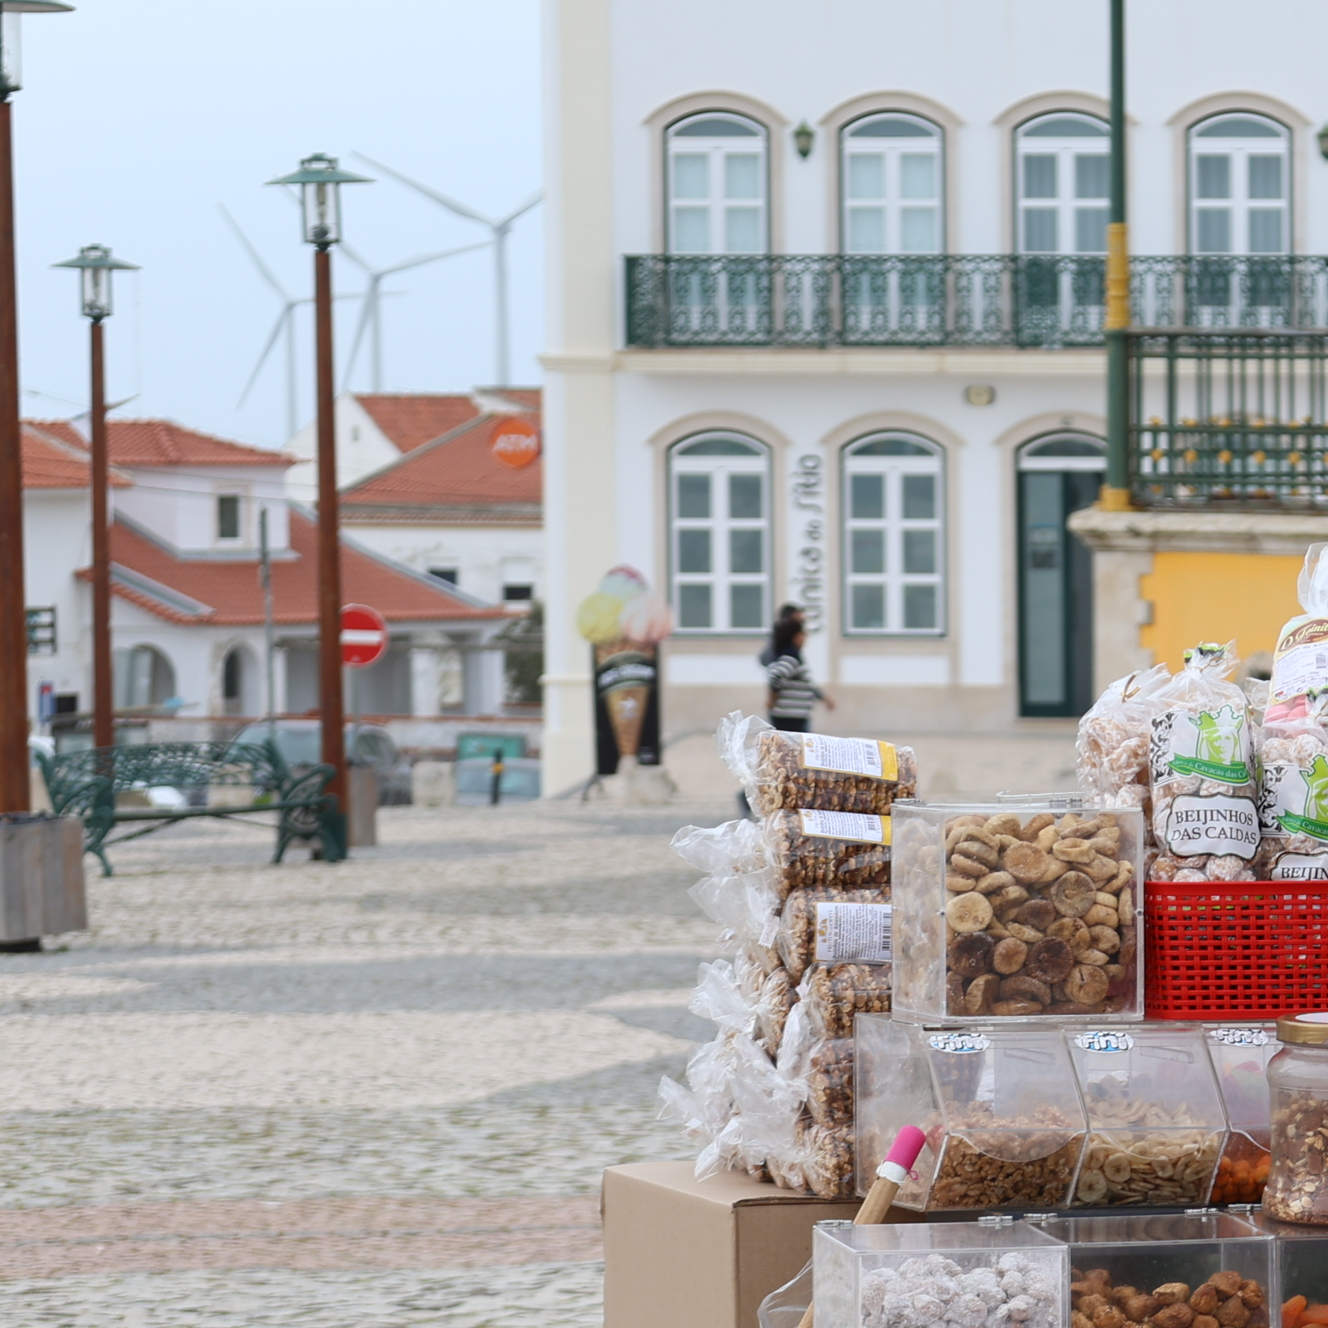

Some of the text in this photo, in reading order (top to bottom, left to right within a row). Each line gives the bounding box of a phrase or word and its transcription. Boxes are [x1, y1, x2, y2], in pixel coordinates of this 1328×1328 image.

[492, 433, 539, 453] ATM
[1175, 808, 1254, 825] BEIJINHOS
[1171, 826, 1257, 846] DAS CALDAS
